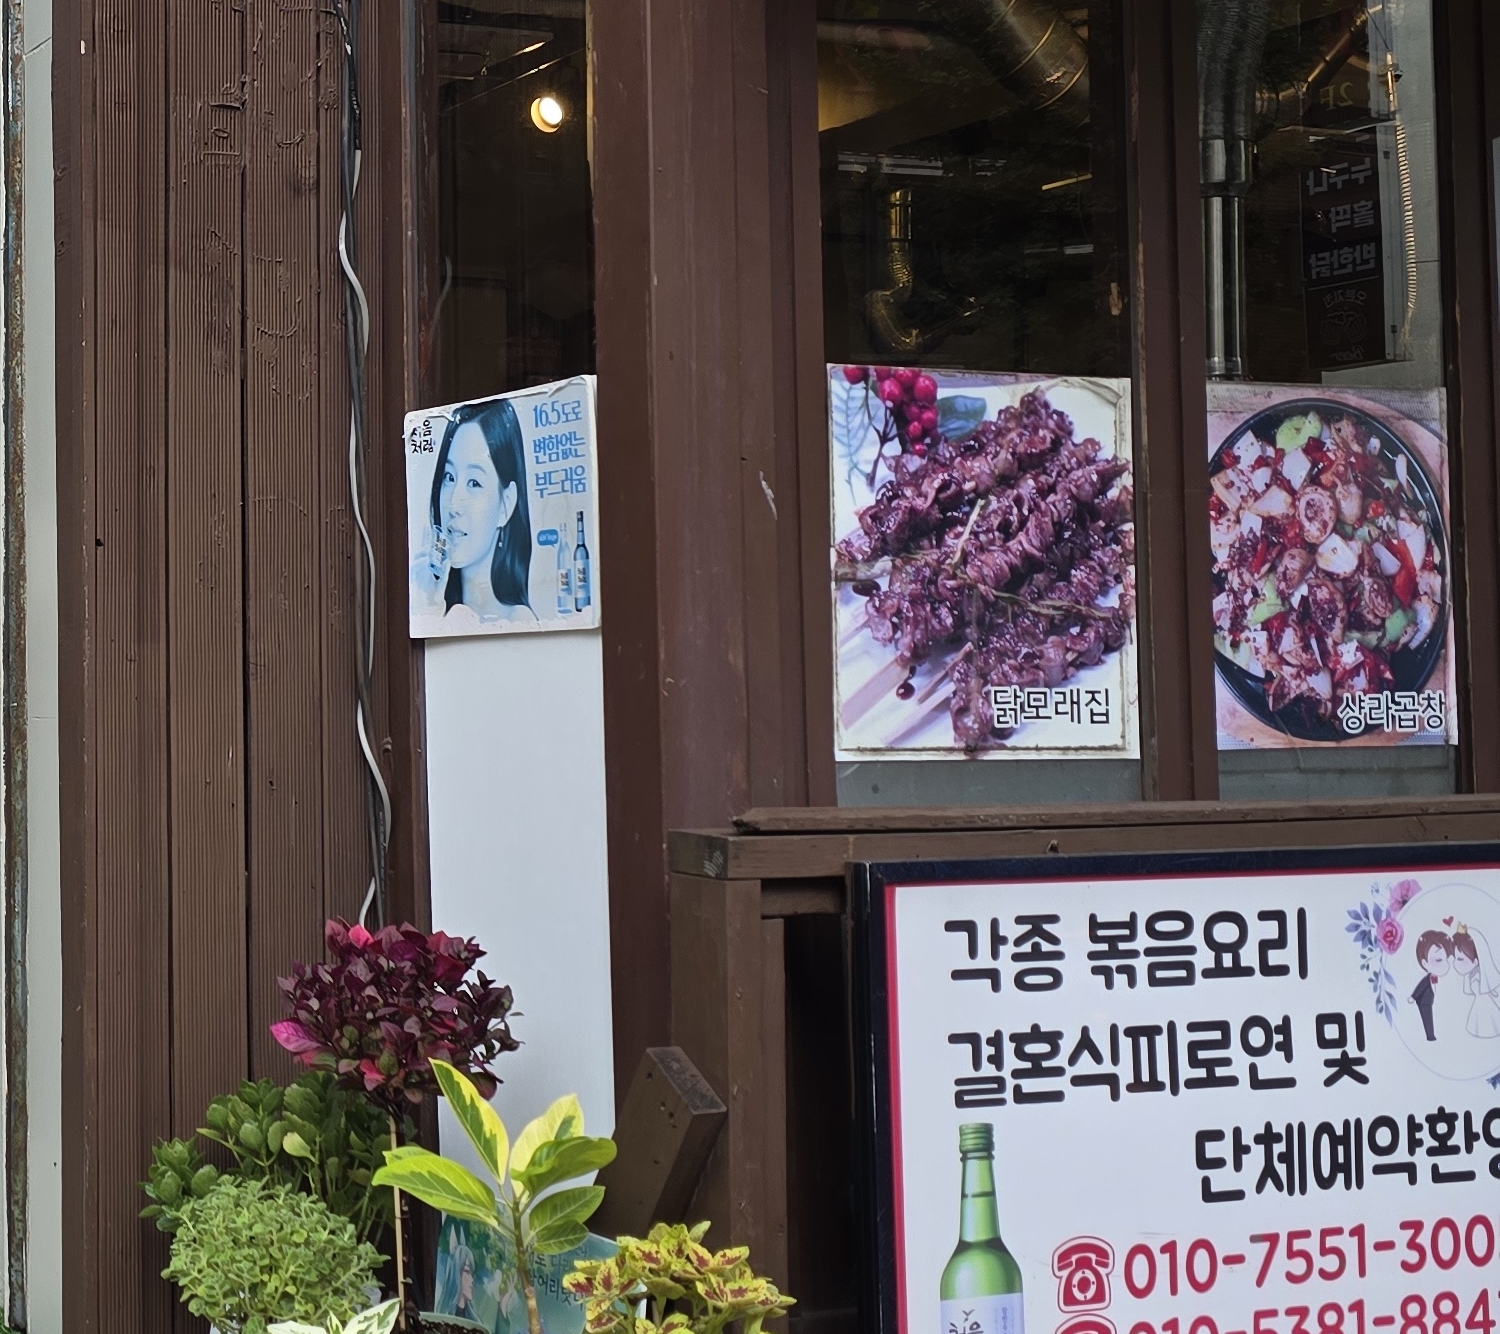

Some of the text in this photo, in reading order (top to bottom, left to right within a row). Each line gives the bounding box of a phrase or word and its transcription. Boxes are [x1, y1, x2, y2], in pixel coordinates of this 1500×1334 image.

[532, 431, 587, 465] 변함없는
[534, 465, 587, 499] 부드러움
[992, 686, 1111, 726] 닭모래집
[1338, 691, 1447, 732] 샹라곱창
[944, 906, 1309, 994] 각종 볶음요리
[947, 1009, 1370, 1109] 결혼식피로연 및
[1124, 1214, 1500, 1299] 010-7551-300
